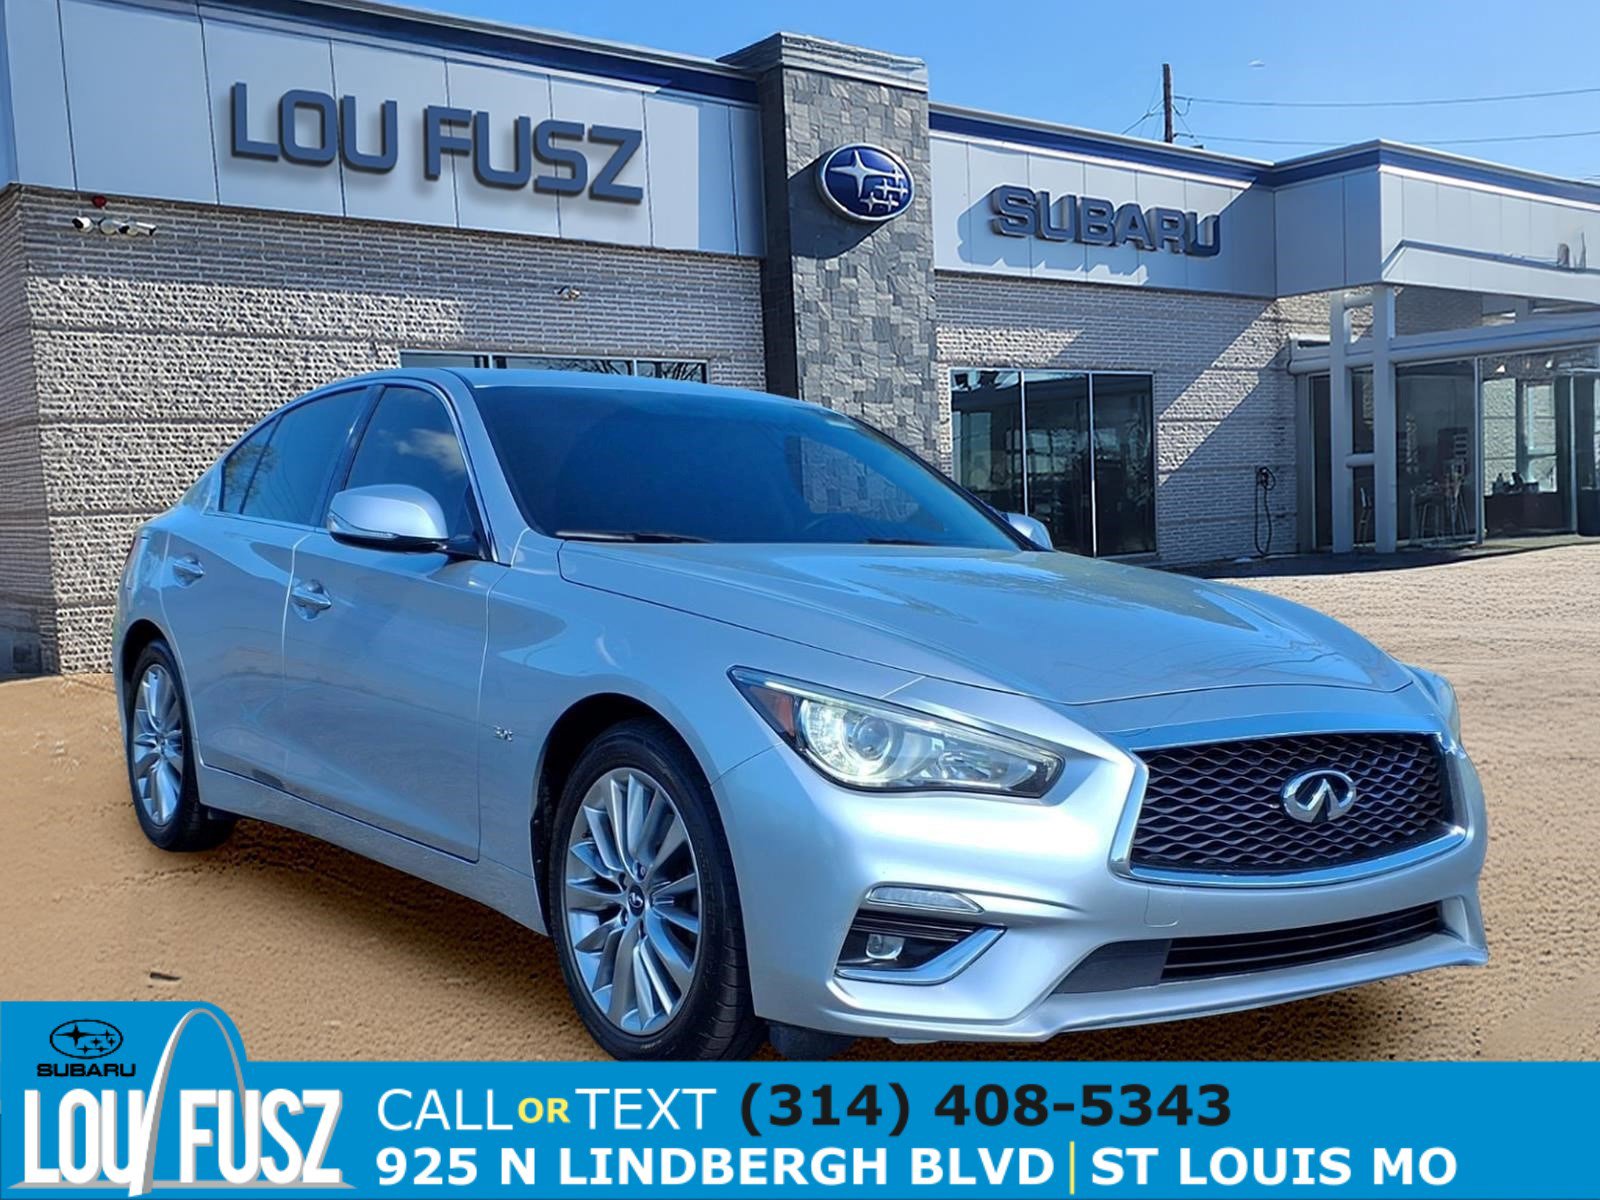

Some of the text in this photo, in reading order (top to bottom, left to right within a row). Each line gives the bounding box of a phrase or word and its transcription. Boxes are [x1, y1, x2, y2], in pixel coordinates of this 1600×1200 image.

[230, 82, 643, 204] LOU FUSZ
[990, 184, 1221, 257] SUBARU
